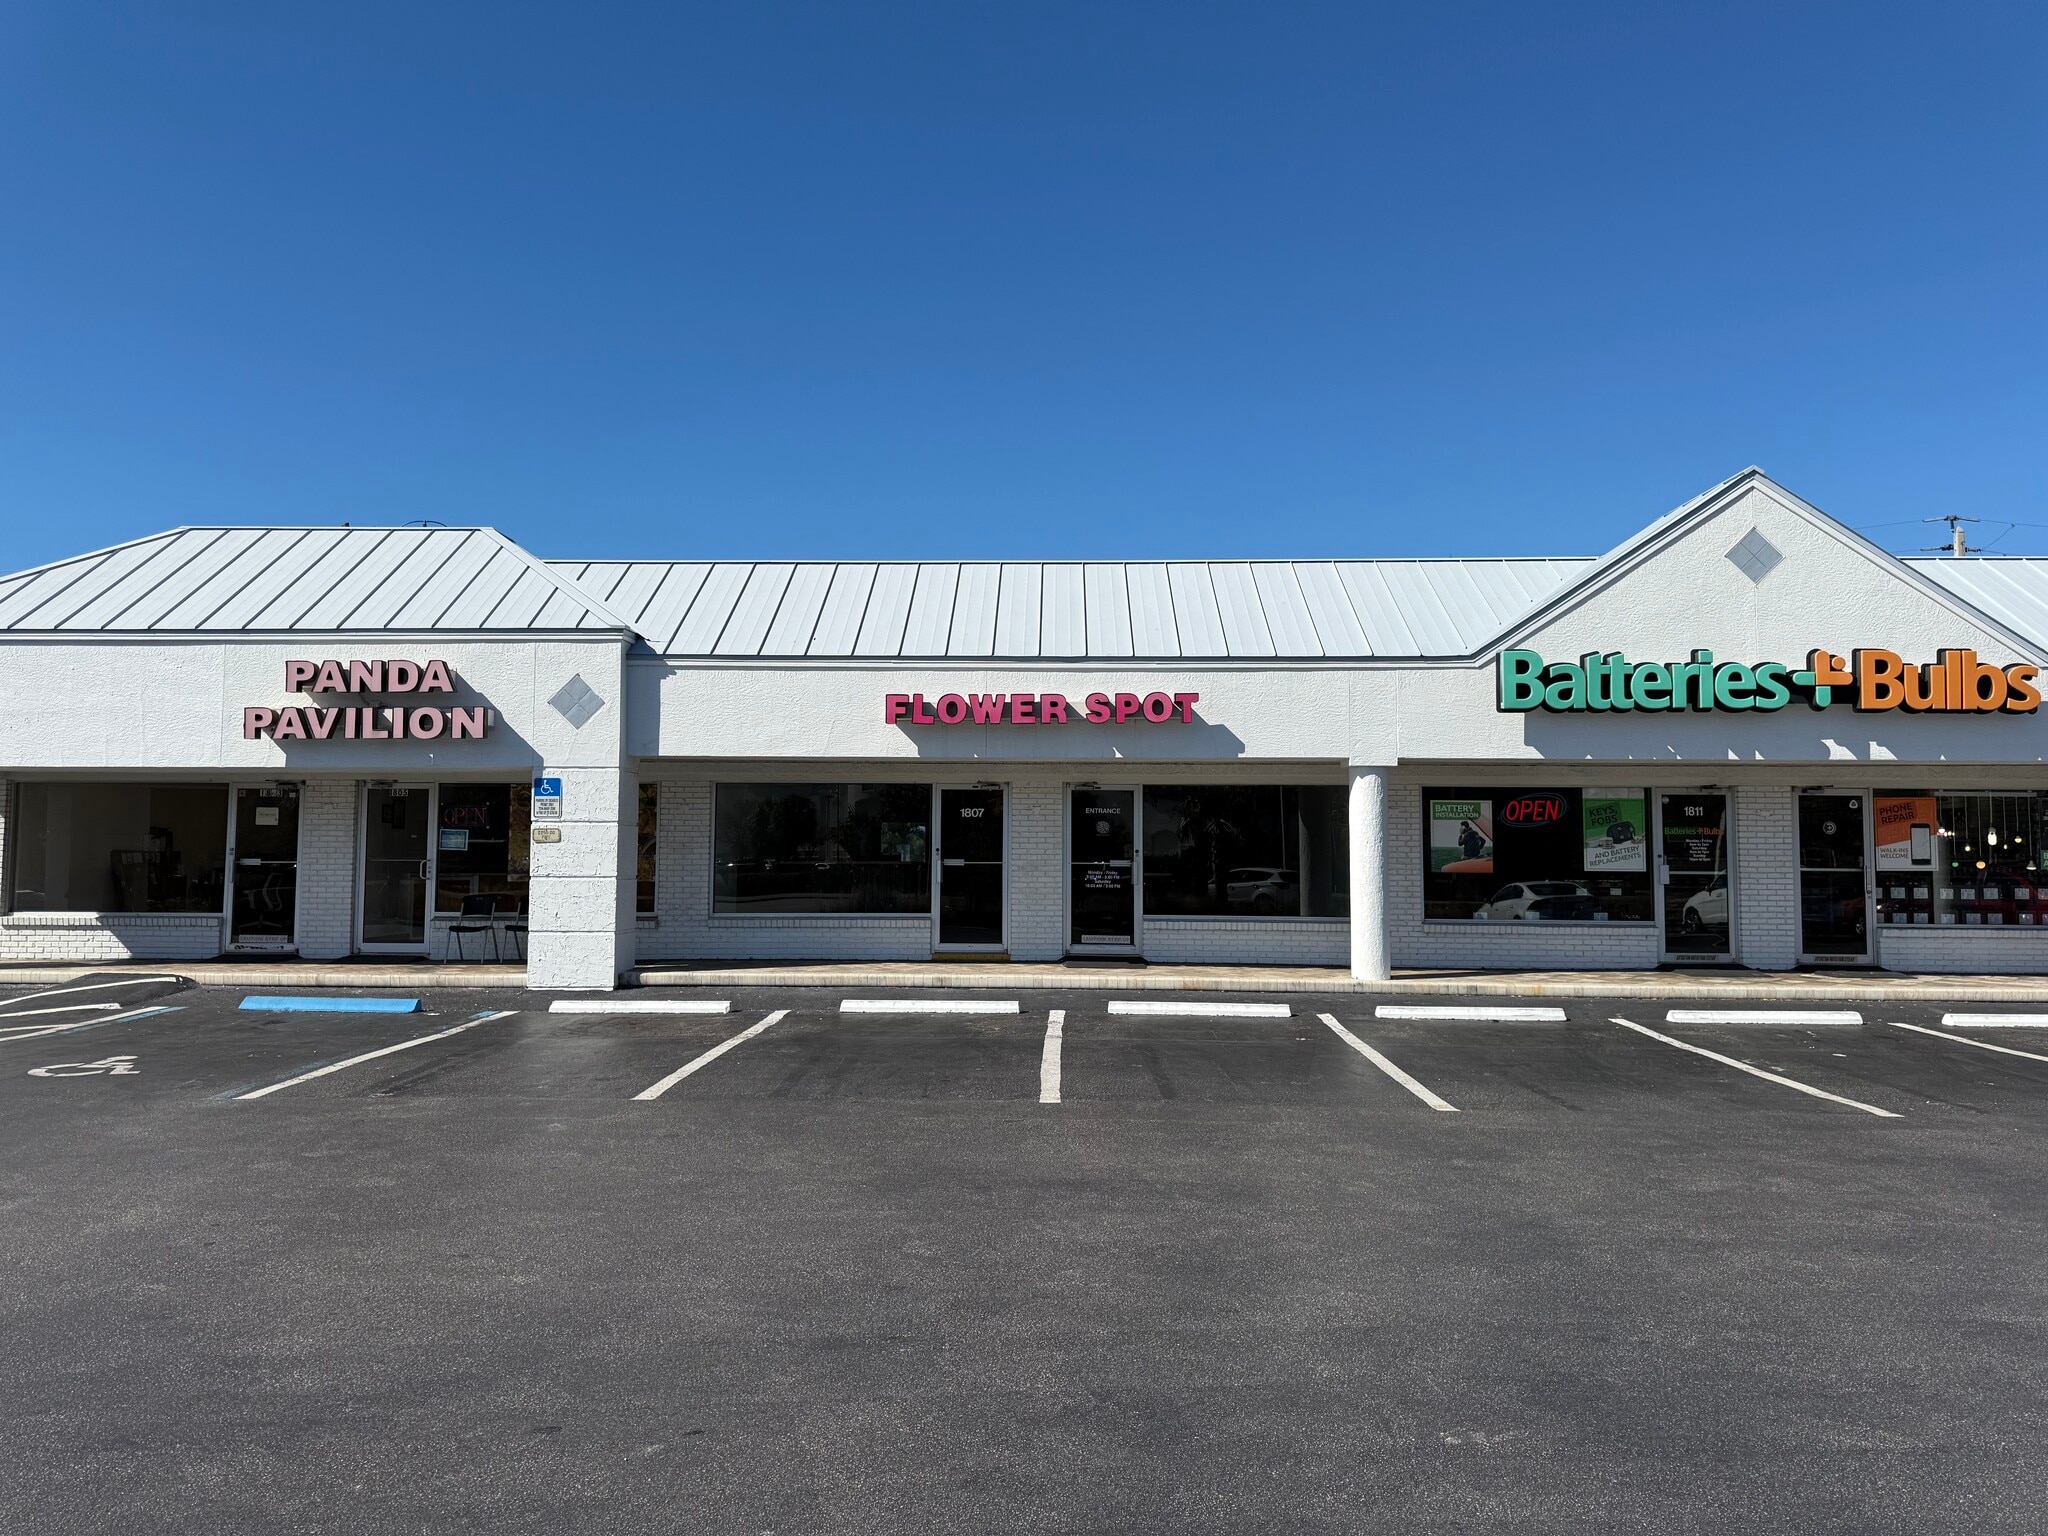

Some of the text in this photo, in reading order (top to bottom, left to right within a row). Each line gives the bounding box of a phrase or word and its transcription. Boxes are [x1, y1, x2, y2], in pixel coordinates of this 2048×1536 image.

[285, 660, 458, 693] PANDA
[1497, 649, 1791, 712] Batteries
[1854, 649, 2041, 713] Bulbs
[885, 692, 1200, 724] FLOWER SPOT
[244, 707, 488, 739] PAVILION
[960, 808, 985, 817] 1807
[1435, 804, 1475, 812] BATTERY
[1506, 800, 1560, 822] OPEN
[1589, 805, 1618, 818] KEYS,
[1684, 806, 1704, 816] 1811
[1879, 802, 1913, 816] PHONE
[443, 807, 487, 825] OPEN
[1591, 814, 1618, 826] FOBS
[1881, 811, 1915, 825] REPAIR
[1664, 826, 1697, 835] Batteries
[1594, 845, 1640, 859] AND BATTERY
[1589, 852, 1641, 867] REPLACEMENTS
